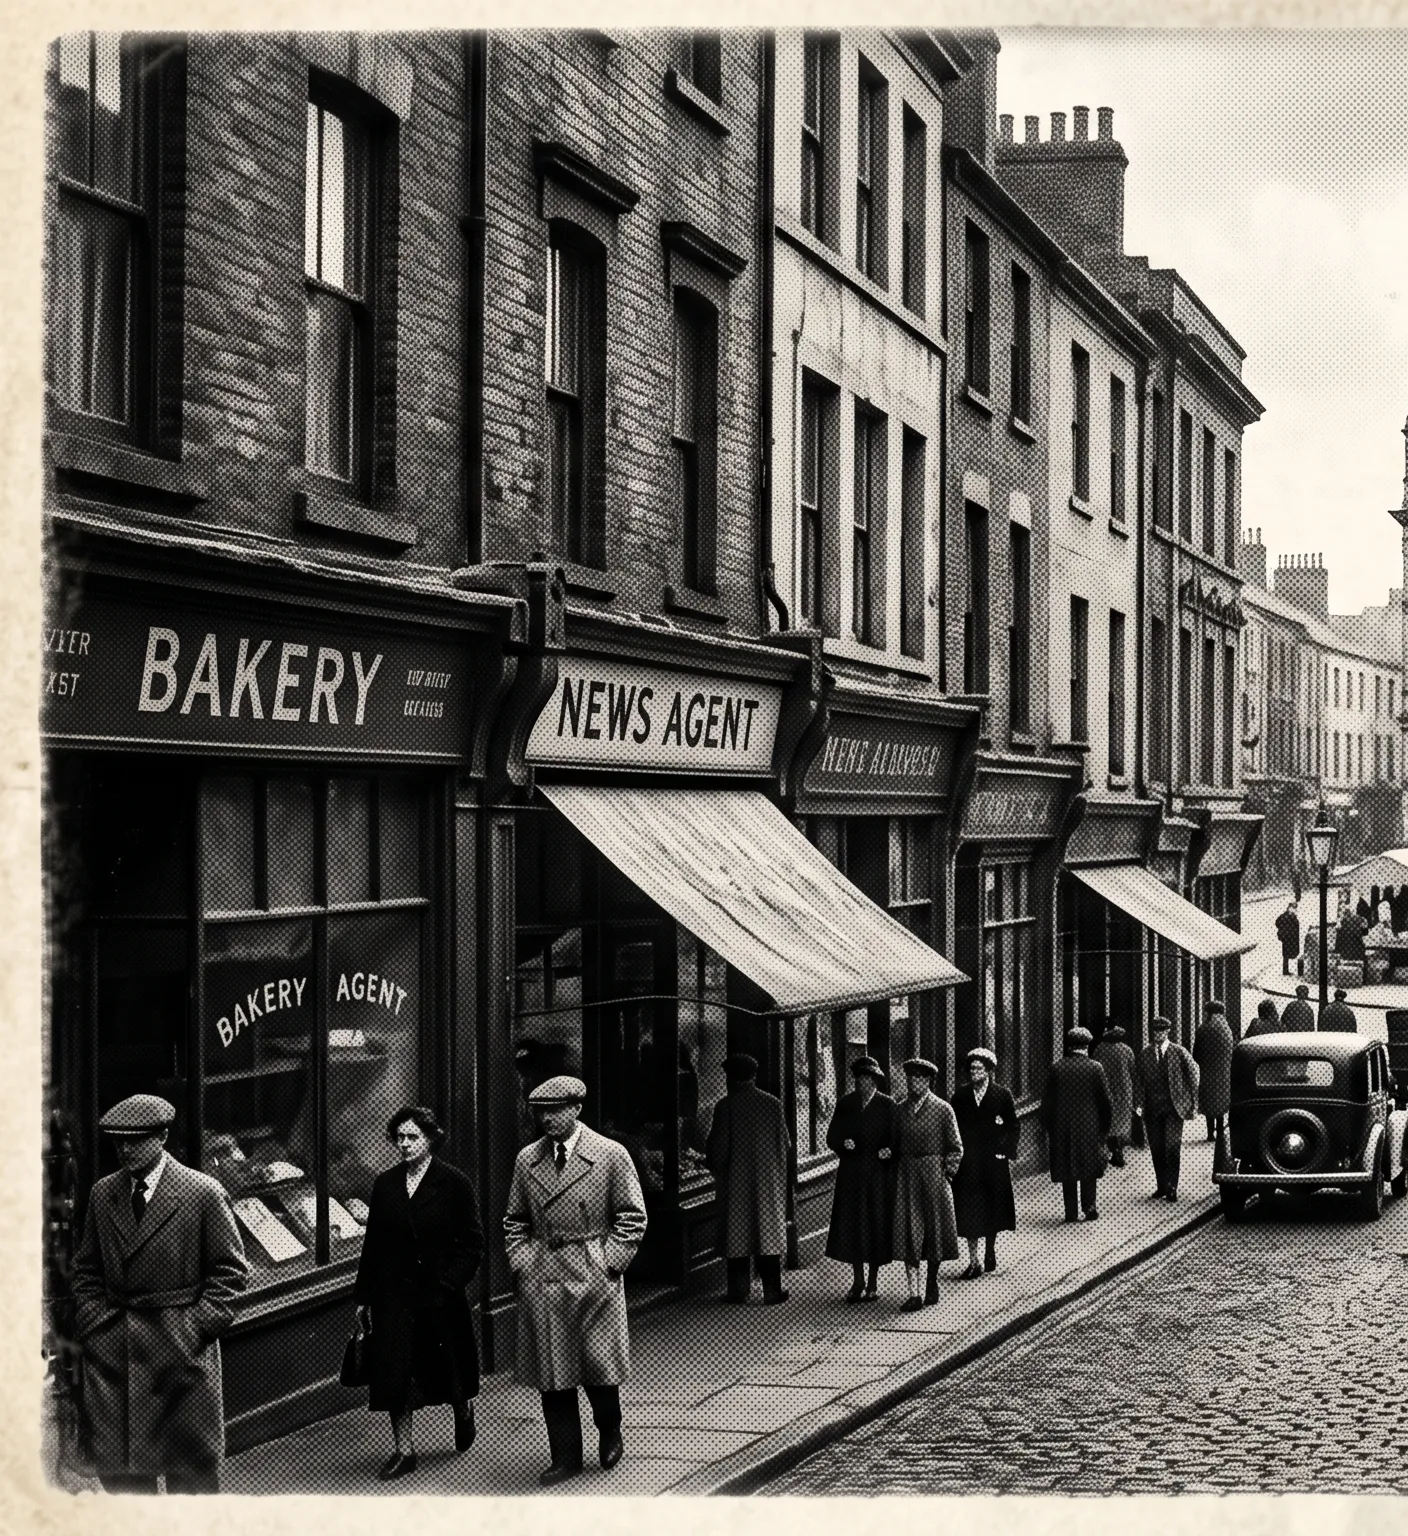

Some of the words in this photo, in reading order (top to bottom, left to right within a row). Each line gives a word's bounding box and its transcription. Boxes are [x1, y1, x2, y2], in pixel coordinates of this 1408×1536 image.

[138, 626, 384, 725] BAKERY
[557, 677, 654, 744] NEWS
[661, 692, 759, 751] AGENT
[216, 977, 307, 1047] BAKERY
[336, 972, 408, 1015] AGENT
